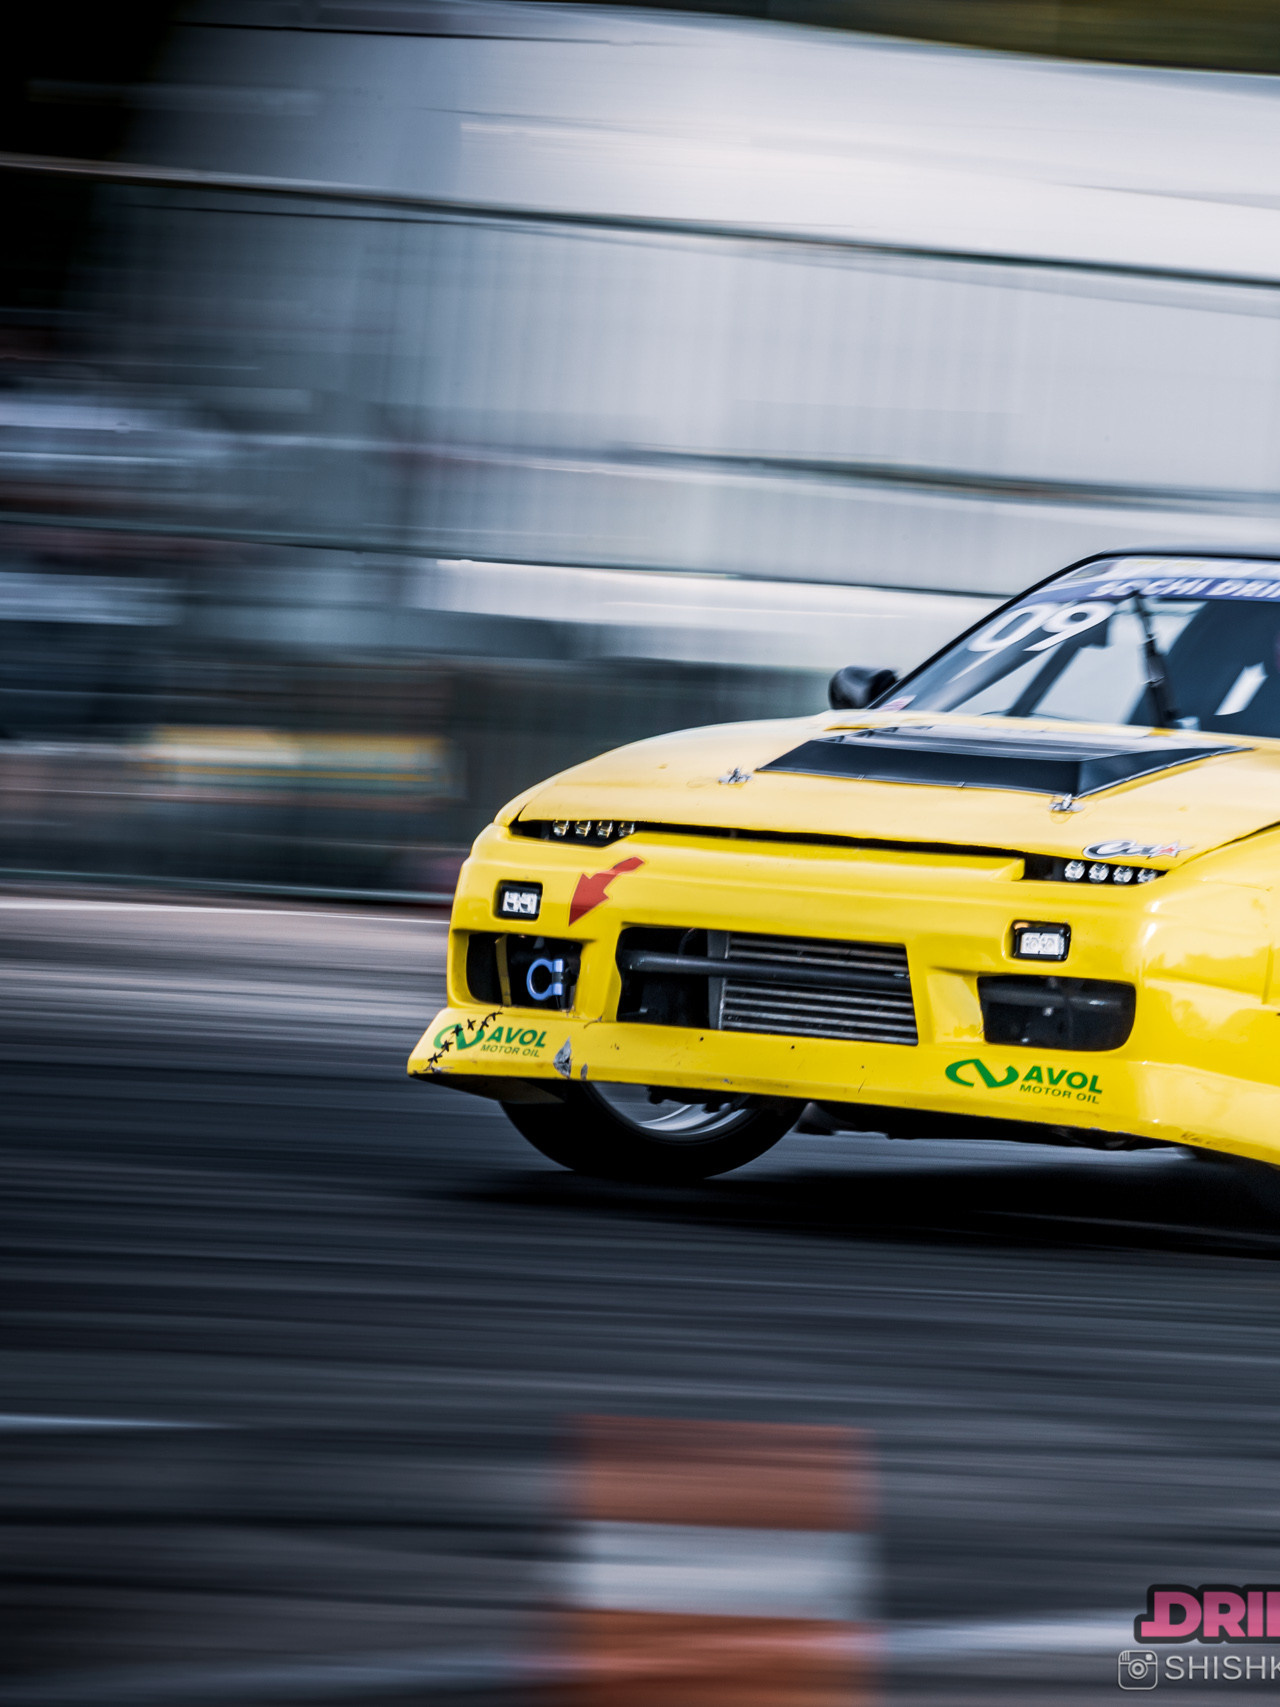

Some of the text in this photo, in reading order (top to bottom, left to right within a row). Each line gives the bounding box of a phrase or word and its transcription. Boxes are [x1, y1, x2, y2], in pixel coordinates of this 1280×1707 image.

[1088, 577, 1214, 598] SOCHI
[967, 601, 1116, 652] 09
[486, 1026, 547, 1048] AVOL
[481, 1044, 541, 1058] MOTOR OIL
[1022, 1065, 1103, 1094] AVOL
[1019, 1085, 1100, 1104] MOTOR OIL
